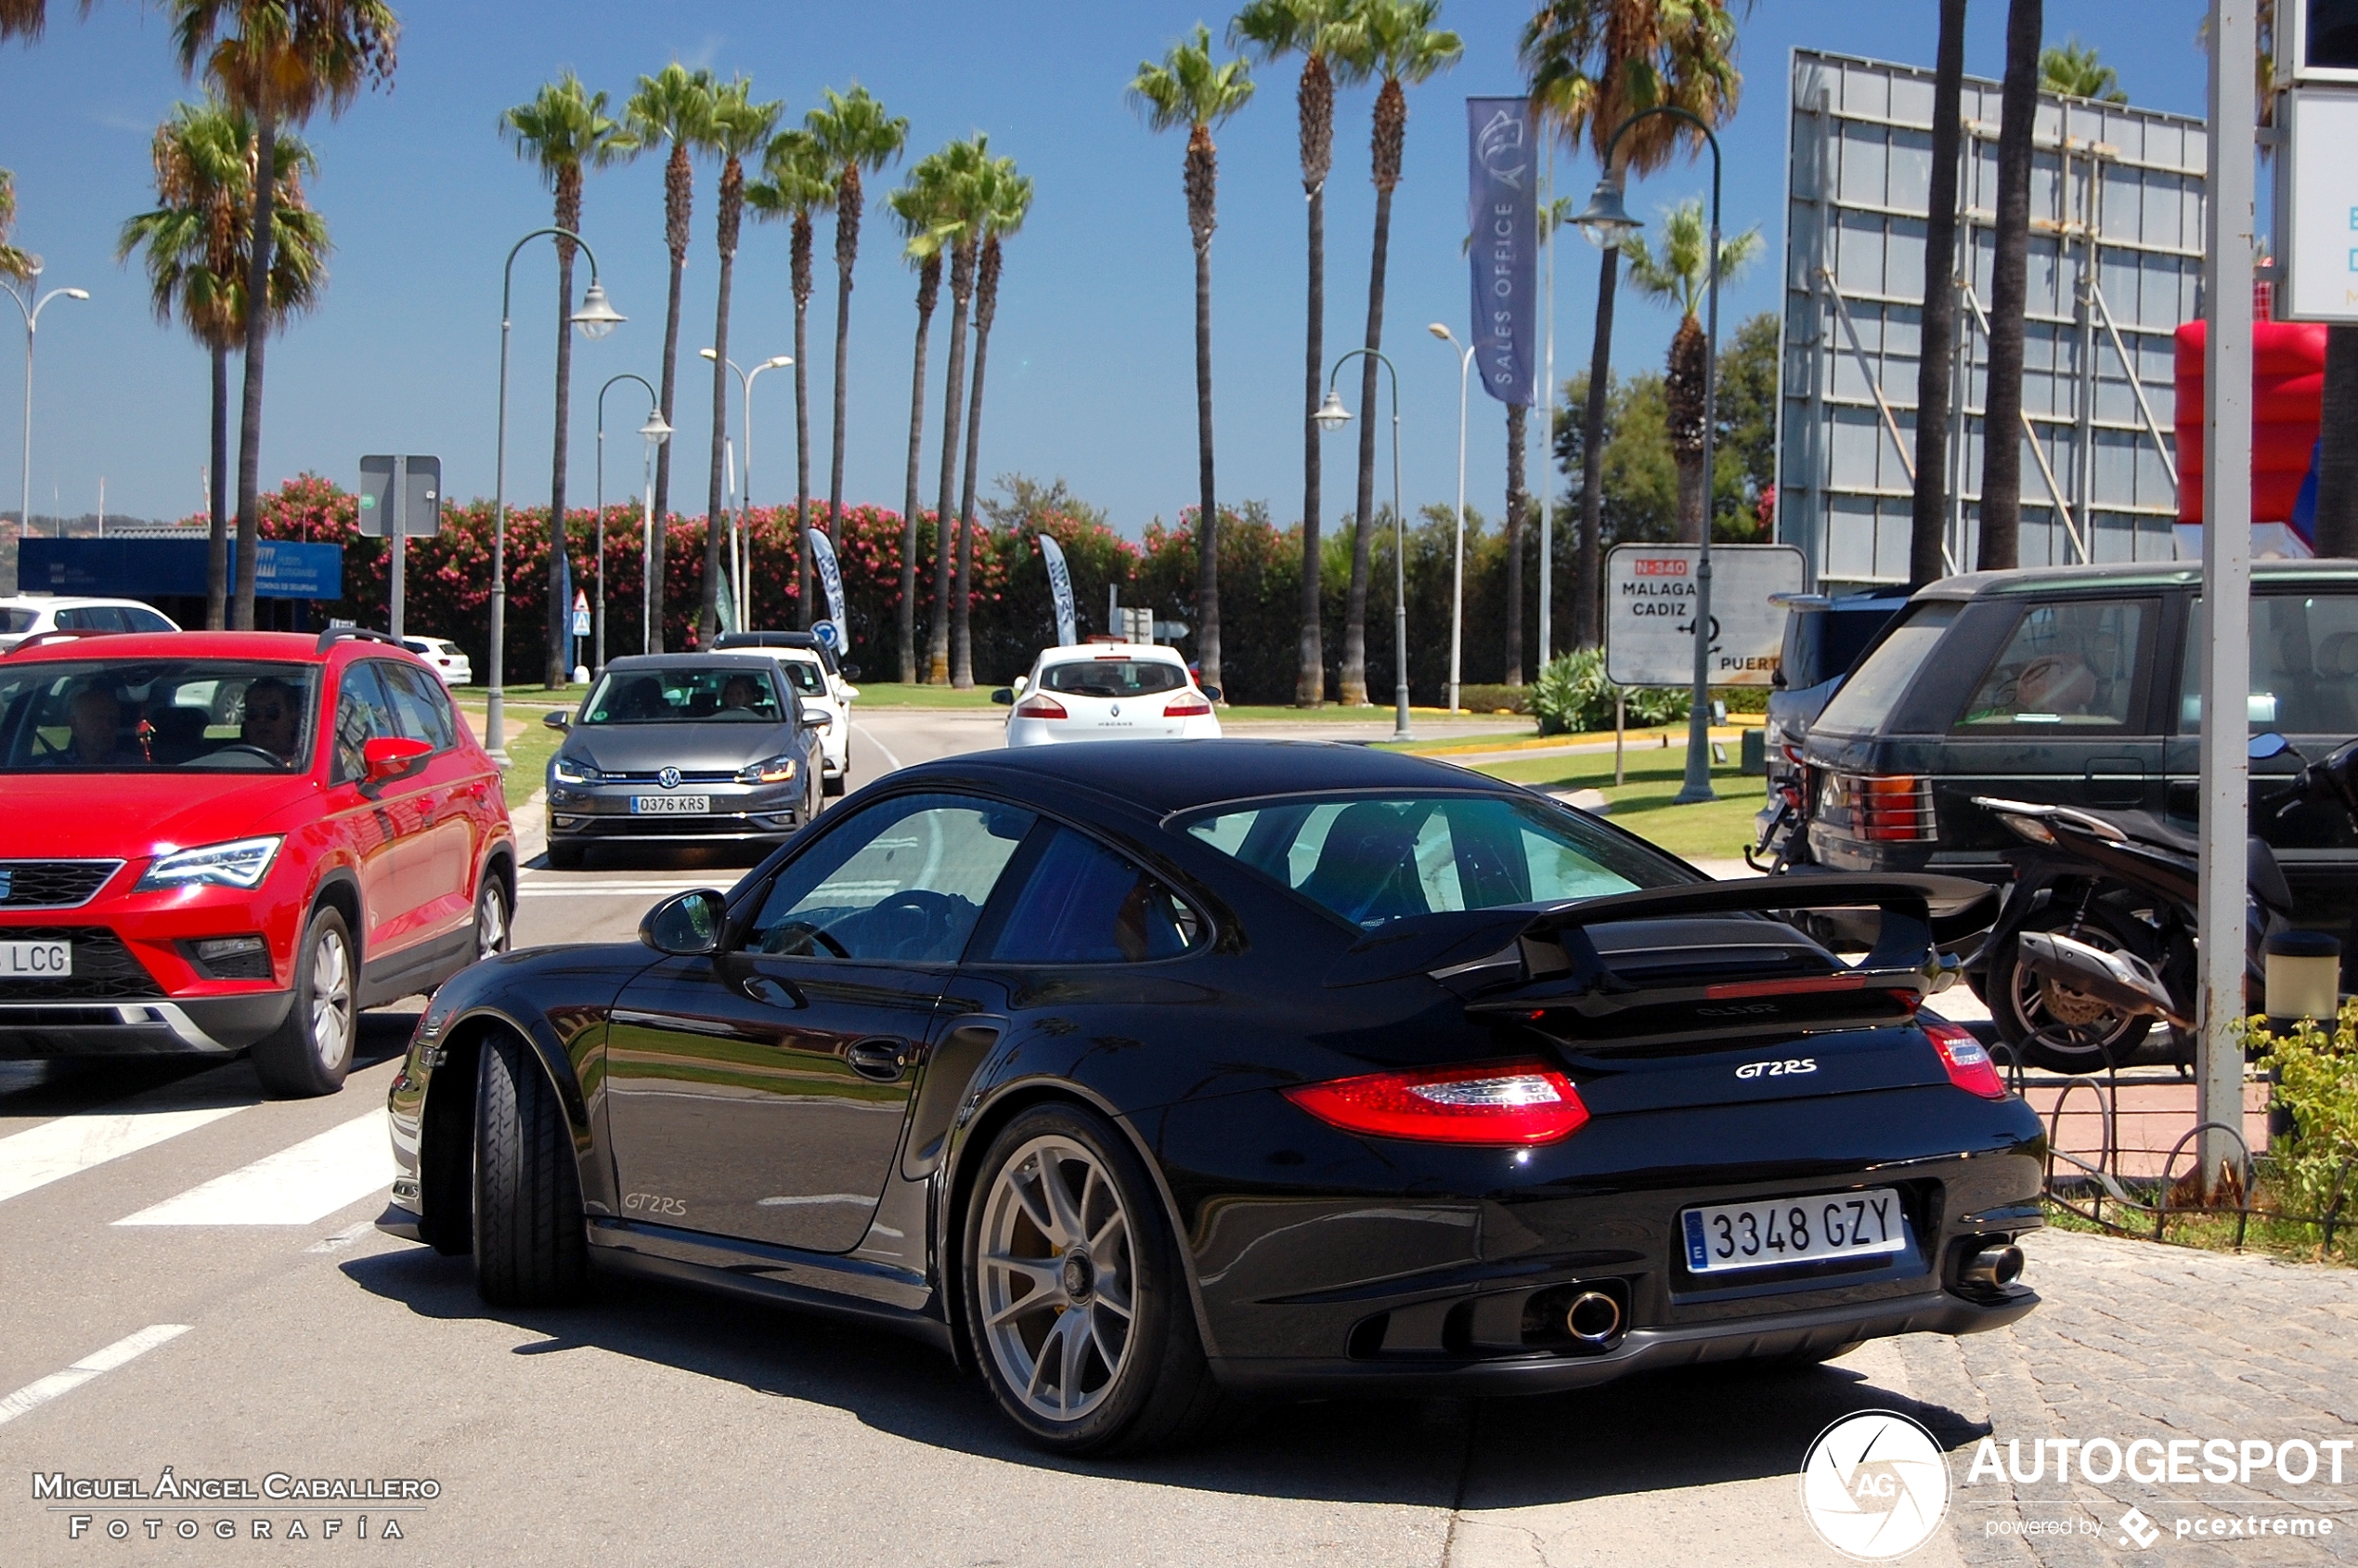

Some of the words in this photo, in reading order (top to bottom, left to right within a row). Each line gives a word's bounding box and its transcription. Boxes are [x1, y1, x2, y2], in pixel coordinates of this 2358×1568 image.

[1495, 203, 1512, 297] OFFICE
[1495, 311, 1512, 385] SALES
[1623, 582, 1697, 595] MALAGA
[1633, 603, 1687, 616] CADIZ
[1721, 657, 1781, 670] PUERT
[641, 798, 674, 811] 0376
[680, 798, 705, 810] KRS
[13, 946, 64, 971] LCG
[1713, 1207, 1810, 1259] 3348
[1823, 1198, 1889, 1248] GZY
